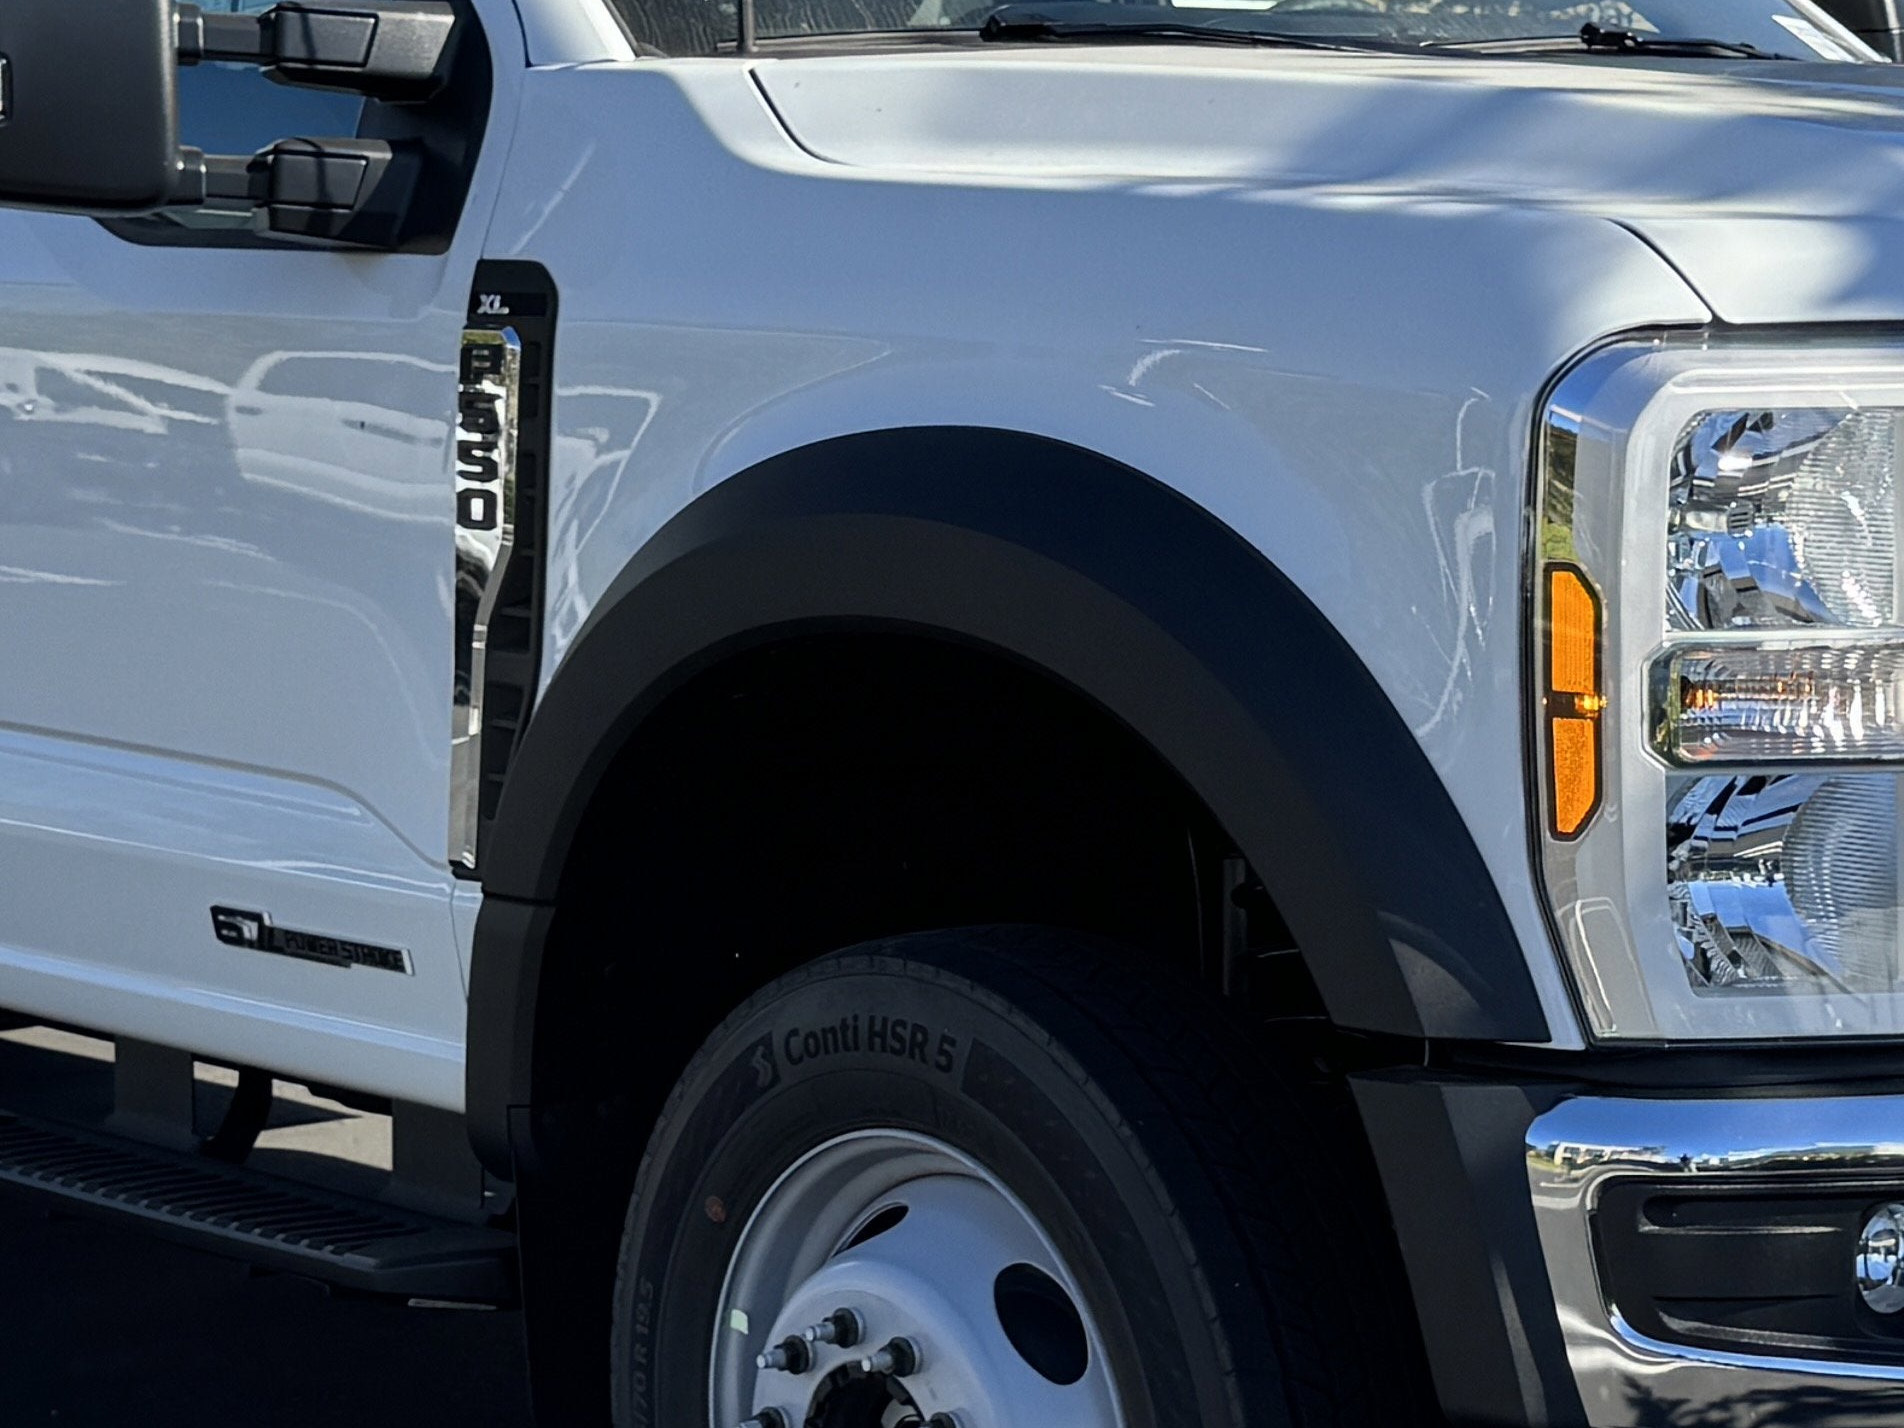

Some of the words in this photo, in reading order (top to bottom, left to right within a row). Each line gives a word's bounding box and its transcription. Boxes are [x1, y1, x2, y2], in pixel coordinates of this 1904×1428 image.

[477, 294, 510, 315] XL
[784, 1013, 860, 1066] Conti
[867, 1015, 929, 1065] HSR
[935, 1033, 957, 1074] 5
